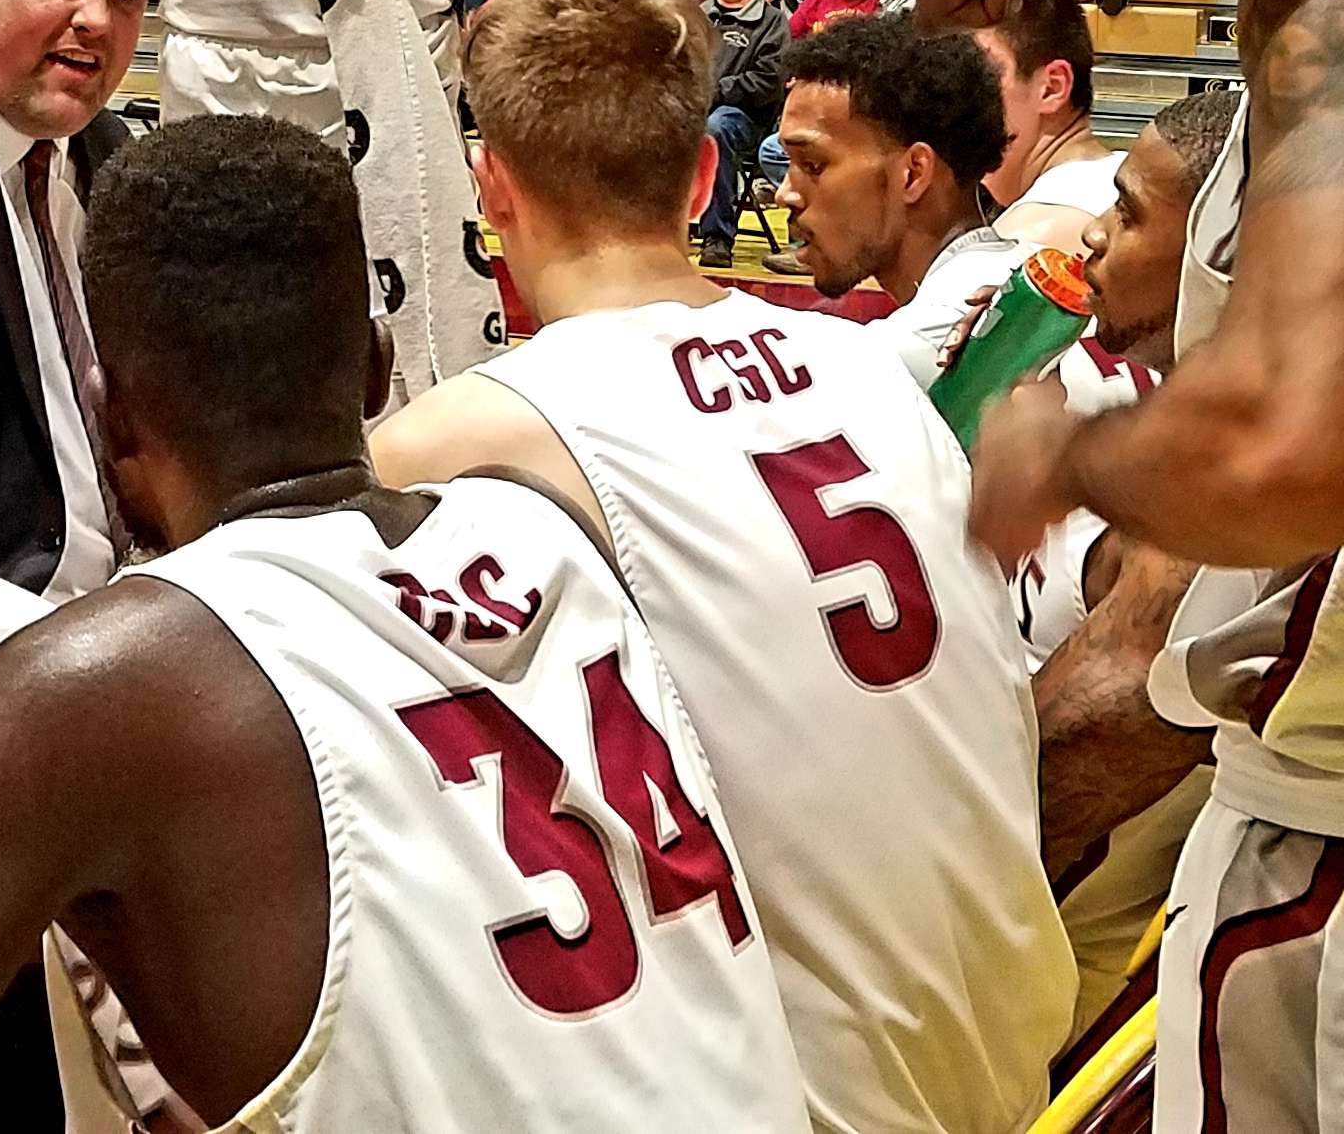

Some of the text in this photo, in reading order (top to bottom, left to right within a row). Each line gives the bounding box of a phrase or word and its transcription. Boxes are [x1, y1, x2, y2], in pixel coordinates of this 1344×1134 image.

[671, 327, 814, 414] CSC
[748, 432, 943, 692] 5
[394, 650, 756, 1017] 34
